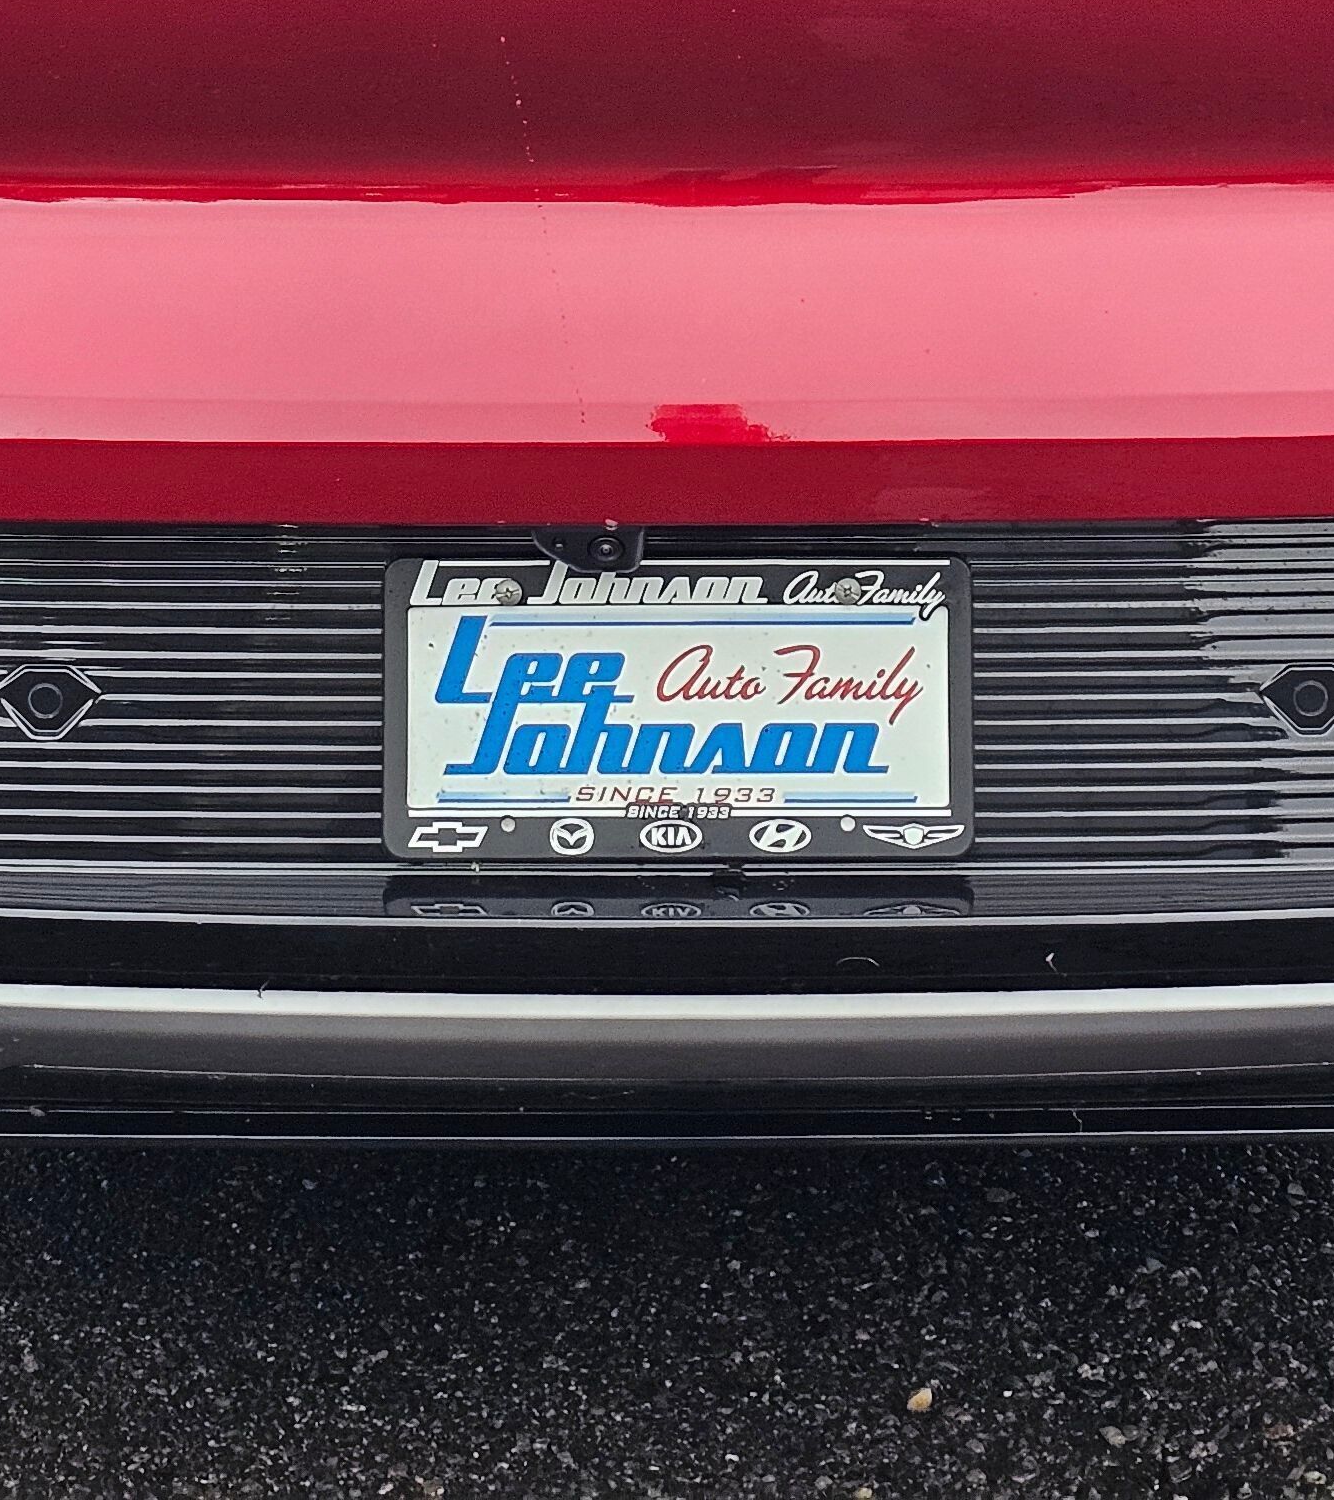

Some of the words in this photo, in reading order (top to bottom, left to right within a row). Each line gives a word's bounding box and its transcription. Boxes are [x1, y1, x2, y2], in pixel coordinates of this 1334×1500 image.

[527, 561, 768, 605] Johnson
[783, 570, 851, 605] Aut
[854, 570, 946, 619] Family
[435, 615, 635, 703] Lee
[656, 645, 765, 704] Auto
[774, 644, 924, 725] Family
[443, 685, 889, 775] Johnson
[576, 786, 678, 803] SINCE
[696, 787, 776, 803] 1933
[627, 805, 681, 818] SINCE
[688, 805, 730, 818] 1933
[651, 826, 692, 846] KIA
